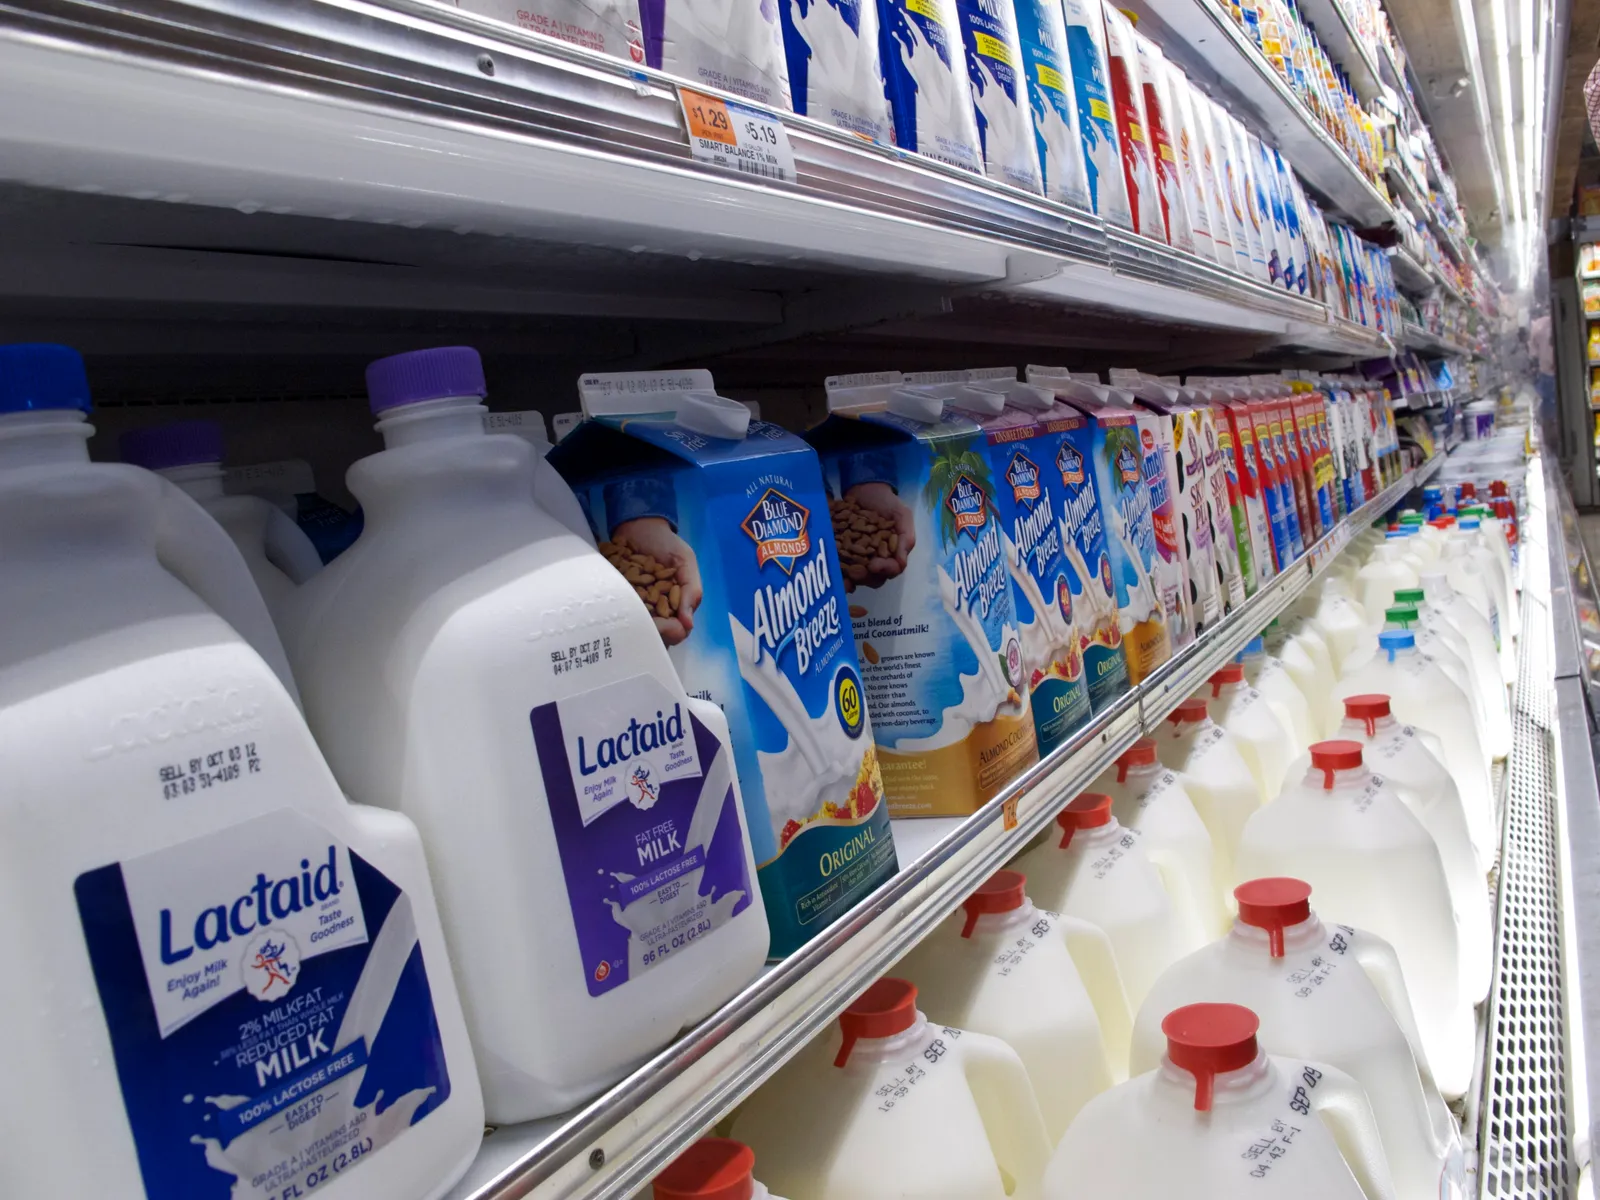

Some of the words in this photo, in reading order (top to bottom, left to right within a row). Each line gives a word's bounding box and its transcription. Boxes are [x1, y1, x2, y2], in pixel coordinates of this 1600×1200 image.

[516, 9, 548, 27] GRADE
[564, 23, 596, 40] VITAMIN
[698, 67, 722, 80] GRADE
[733, 78, 760, 93] VITAMINS
[692, 105, 728, 130] $1.29
[745, 121, 778, 146] $5.19
[699, 138, 722, 154] SMART
[724, 145, 756, 160] BALANCE
[756, 152, 765, 163] 1%
[765, 154, 778, 165] Milk
[1010, 468, 1036, 486] DIAMOND
[1014, 459, 1028, 473] BLUE
[1059, 457, 1080, 472] DIAMOND
[745, 481, 760, 498] ALL
[759, 474, 793, 491] NATURAL
[957, 482, 973, 497] BLUE
[1015, 485, 1040, 498] ALMONDS
[762, 499, 789, 521] BLUE
[951, 491, 982, 514] DIAMOND
[1064, 473, 1096, 545] Almond
[752, 511, 804, 541] DIAMOND
[957, 512, 985, 527] ALMONDS
[1014, 487, 1053, 568] Almond
[1082, 508, 1101, 553] Breeze
[761, 538, 808, 555] ALMONDS
[1035, 526, 1059, 578] Breeze
[954, 515, 1000, 611] Almond
[753, 538, 831, 664] Almond
[981, 563, 1005, 620] Breeze
[853, 630, 870, 640] and
[871, 624, 930, 639] Coconutmilk!
[867, 617, 892, 627] blend
[894, 615, 903, 627] of
[794, 596, 840, 676] Breeze
[551, 650, 567, 662] SELL
[569, 646, 577, 658] BY
[580, 643, 590, 654] OCT
[593, 639, 600, 651] 27
[603, 637, 611, 647] 12
[604, 647, 613, 659] P2
[880, 654, 903, 664] growers
[914, 651, 936, 659] known
[882, 663, 904, 671] world's
[1097, 652, 1121, 676] ORIGINAL
[870, 674, 880, 682] the
[881, 673, 906, 681] orchards
[889, 682, 908, 690] knows
[842, 685, 856, 713] 60
[870, 692, 891, 700] better
[878, 702, 890, 710] Our
[891, 700, 917, 708] almonds
[1053, 684, 1081, 714] ORIGINAL
[881, 719, 910, 728] non-dairy
[882, 709, 896, 718] with
[578, 702, 684, 776] Lactaid
[159, 764, 186, 782] SELL
[189, 757, 202, 774] BY
[207, 751, 223, 768] OCT
[245, 741, 257, 757] 12
[248, 758, 261, 773] P2
[664, 756, 693, 772] Goodness
[669, 749, 685, 761] Taste
[584, 781, 602, 796] Enjoy
[603, 776, 617, 787] Milk
[592, 787, 614, 803] Again!
[635, 831, 652, 846] FAT
[652, 819, 675, 838] FREE
[637, 830, 682, 867] MILK
[819, 826, 875, 877] ORIGINAL
[630, 879, 650, 895] 100%
[650, 863, 681, 886] LACTOSE
[681, 855, 698, 869] FREE
[657, 885, 672, 898] EASY
[672, 881, 681, 890] TO
[659, 888, 680, 905] DIGEST
[159, 845, 340, 965] Lactaid
[318, 909, 342, 926] Taste
[310, 916, 354, 943] Goodness
[639, 925, 662, 942] GRADE
[669, 907, 696, 925] VITAMINS
[647, 911, 704, 946] ULTRA-PASTEURIZED
[1032, 919, 1050, 938] SEP
[643, 950, 656, 966] 96
[658, 942, 670, 957] FL
[671, 933, 686, 949] OZ
[687, 918, 711, 941] (2.8L)
[1329, 933, 1348, 955] SEP
[167, 970, 200, 993] Enjoy
[204, 959, 228, 977] Milk
[182, 976, 220, 1001] Again!
[238, 1018, 262, 1040] 2%
[262, 986, 323, 1028] MILKFAT
[235, 1022, 307, 1069] REDUCED
[308, 1006, 336, 1031] FAT
[255, 1027, 329, 1087] MILK
[875, 1077, 906, 1097] SELL
[905, 1062, 918, 1075] BY
[923, 1039, 947, 1064] SEP
[238, 1101, 272, 1124] 100%
[273, 1069, 326, 1106] LACTOSE
[326, 1052, 355, 1076] FREE
[285, 1101, 311, 1122] EASY
[310, 1094, 324, 1108] TO
[288, 1105, 322, 1131] DIGEST
[1240, 1137, 1277, 1161] SELL
[1271, 1118, 1287, 1133] BY
[1289, 1086, 1311, 1116] SEP
[1302, 1065, 1323, 1089] 09
[1282, 1126, 1302, 1145] F-1
[252, 1160, 288, 1188] GRADE
[291, 1155, 298, 1166] A
[304, 1123, 348, 1156] VITAMINS
[264, 1127, 360, 1193] ULTRA-PASTEURIZED
[282, 1185, 303, 1200] FL
[306, 1164, 329, 1188] OZ
[332, 1136, 373, 1173] (2.8L)
